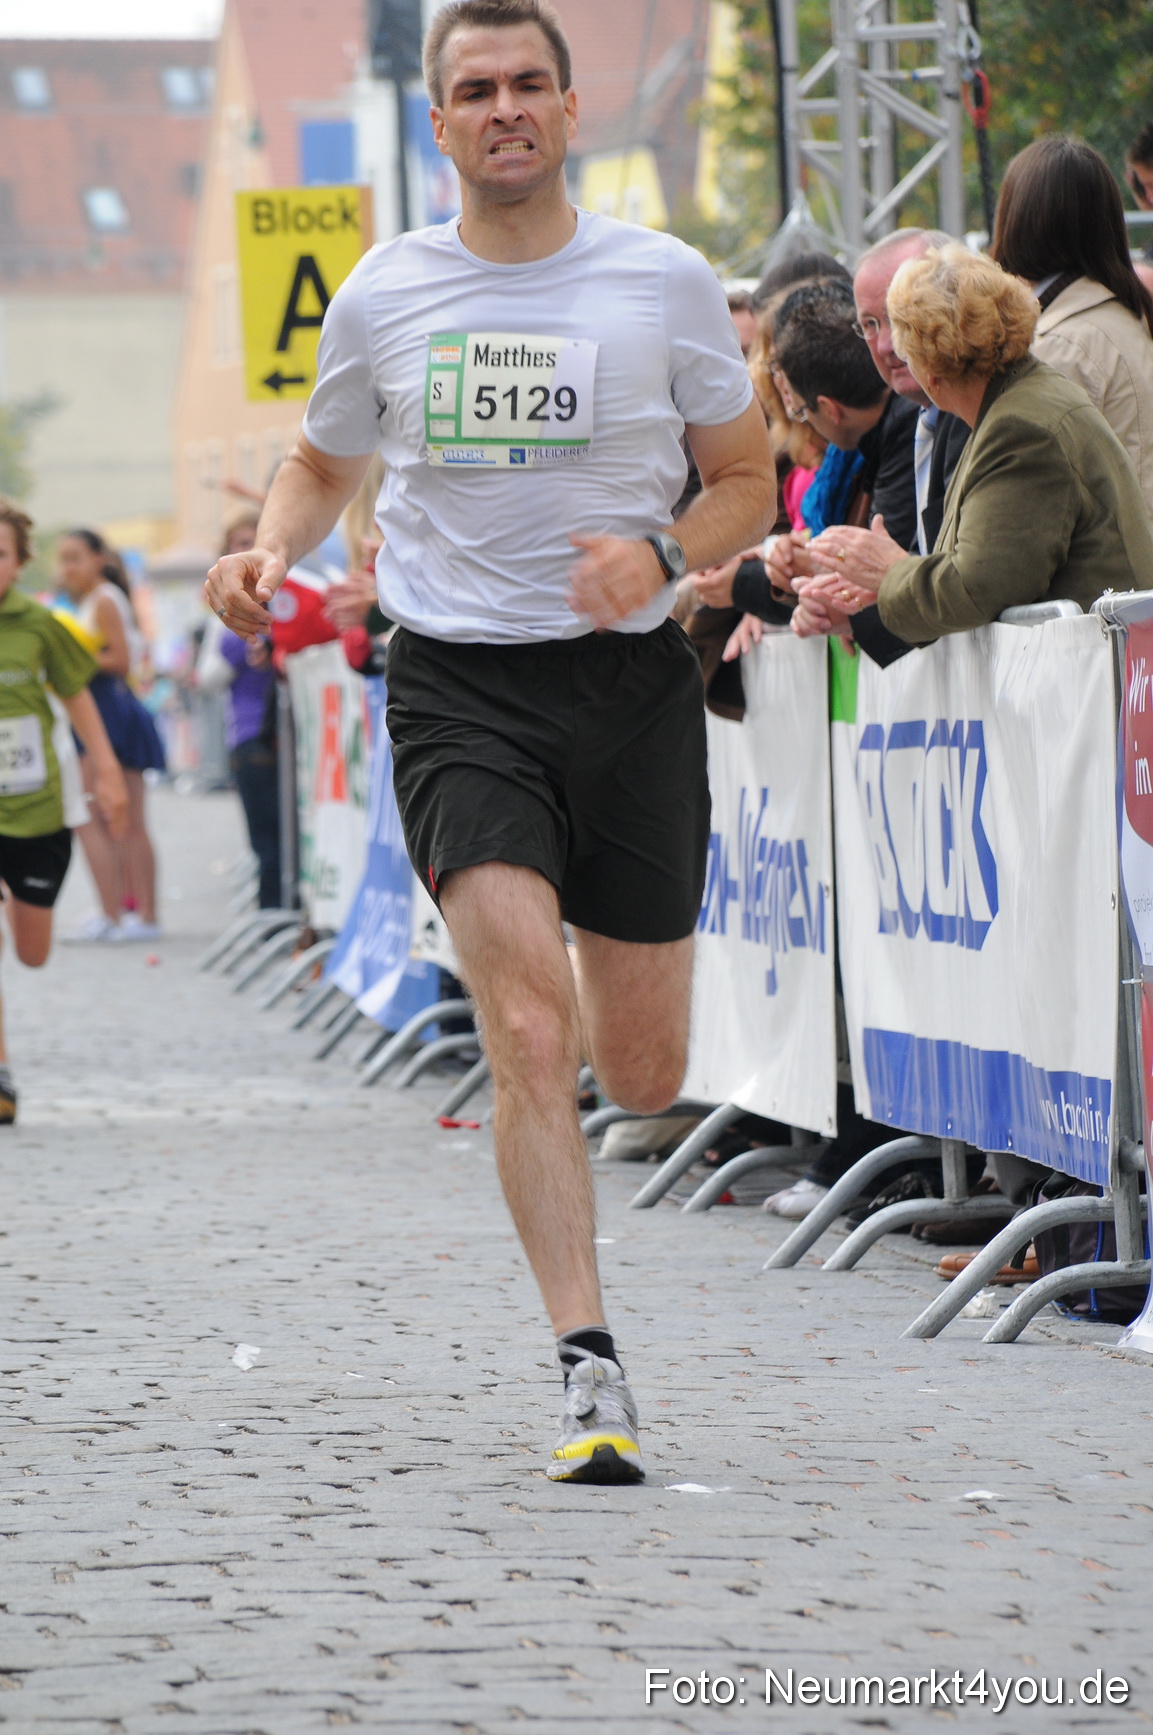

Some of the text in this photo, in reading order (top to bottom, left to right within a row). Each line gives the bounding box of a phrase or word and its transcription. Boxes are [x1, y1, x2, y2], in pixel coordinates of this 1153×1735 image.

[253, 197, 361, 234] Block
[276, 255, 332, 352] A
[474, 343, 557, 368] Matthes
[432, 382, 443, 400] S
[473, 385, 578, 422] 5129
[1128, 656, 1149, 716] Wir
[1134, 740, 1152, 795] im
[857, 718, 999, 951] BOCK
